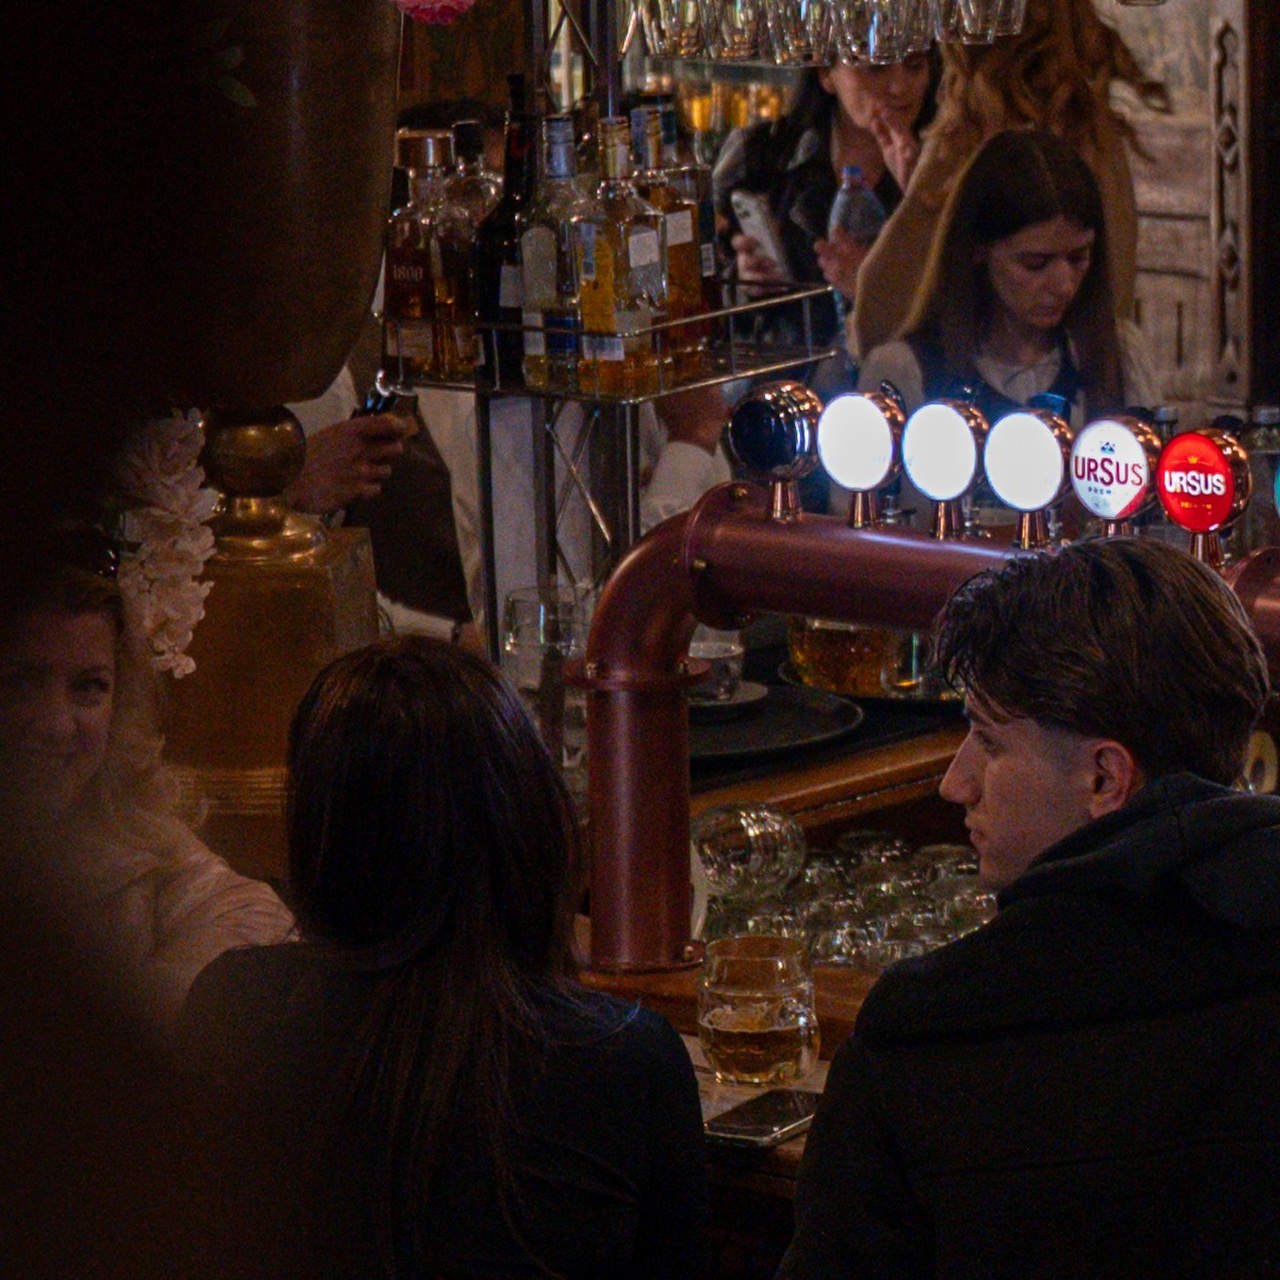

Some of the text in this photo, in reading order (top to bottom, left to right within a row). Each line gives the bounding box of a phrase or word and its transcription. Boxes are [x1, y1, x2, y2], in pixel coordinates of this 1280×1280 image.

[392, 264, 423, 281] 1800
[1074, 455, 1143, 486] URSUS
[1164, 470, 1226, 496] URSUS
